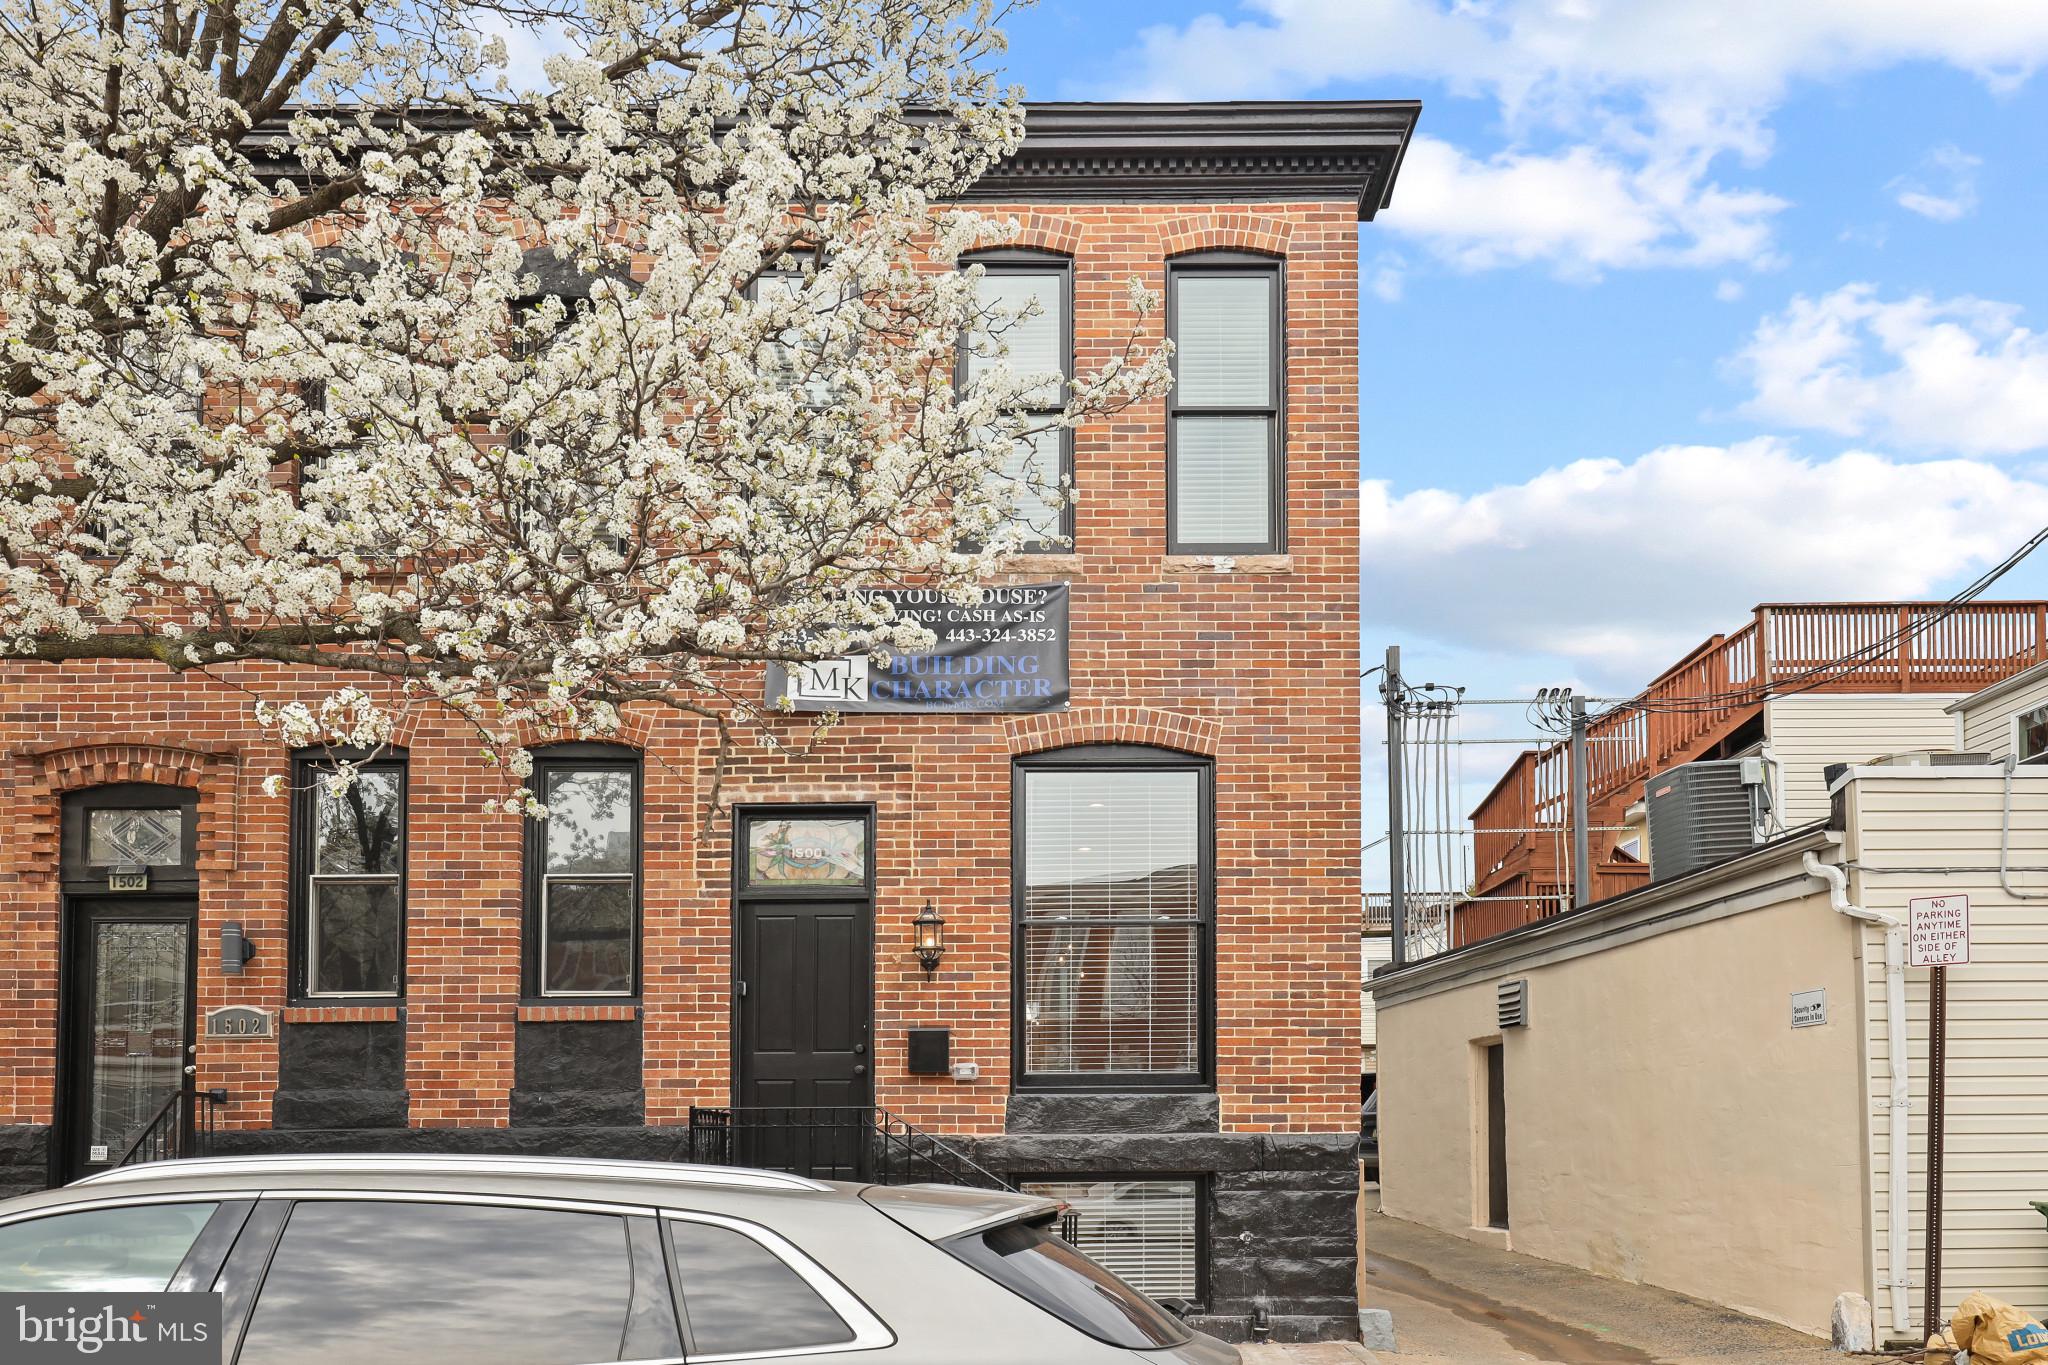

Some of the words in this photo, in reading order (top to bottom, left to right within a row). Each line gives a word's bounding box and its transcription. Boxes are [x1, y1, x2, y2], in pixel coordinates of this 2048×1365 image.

[971, 589, 1048, 605] OUSE?
[889, 609, 942, 622] YING!
[947, 609, 996, 622] CASH
[1001, 610, 1046, 623] AS-IS
[945, 628, 1057, 642] 443-324-3852
[891, 655, 1039, 675] BUILDING
[871, 678, 1051, 700] CHARACTER
[792, 848, 822, 858] 1500
[111, 876, 144, 888] 1502
[1931, 900, 1945, 909] NO
[1916, 909, 1961, 920] PARKING
[1916, 920, 1961, 931] ANYTIME
[1913, 933, 1927, 942] ON
[1930, 930, 1966, 941] EITHER
[1918, 943, 1940, 952] SIDE
[1944, 942, 1957, 951] OF
[1923, 953, 1957, 963] ALLEY
[1794, 1006, 1810, 1014] Security
[1794, 1015, 1810, 1023] Cameras
[212, 1018, 261, 1034] 1502
